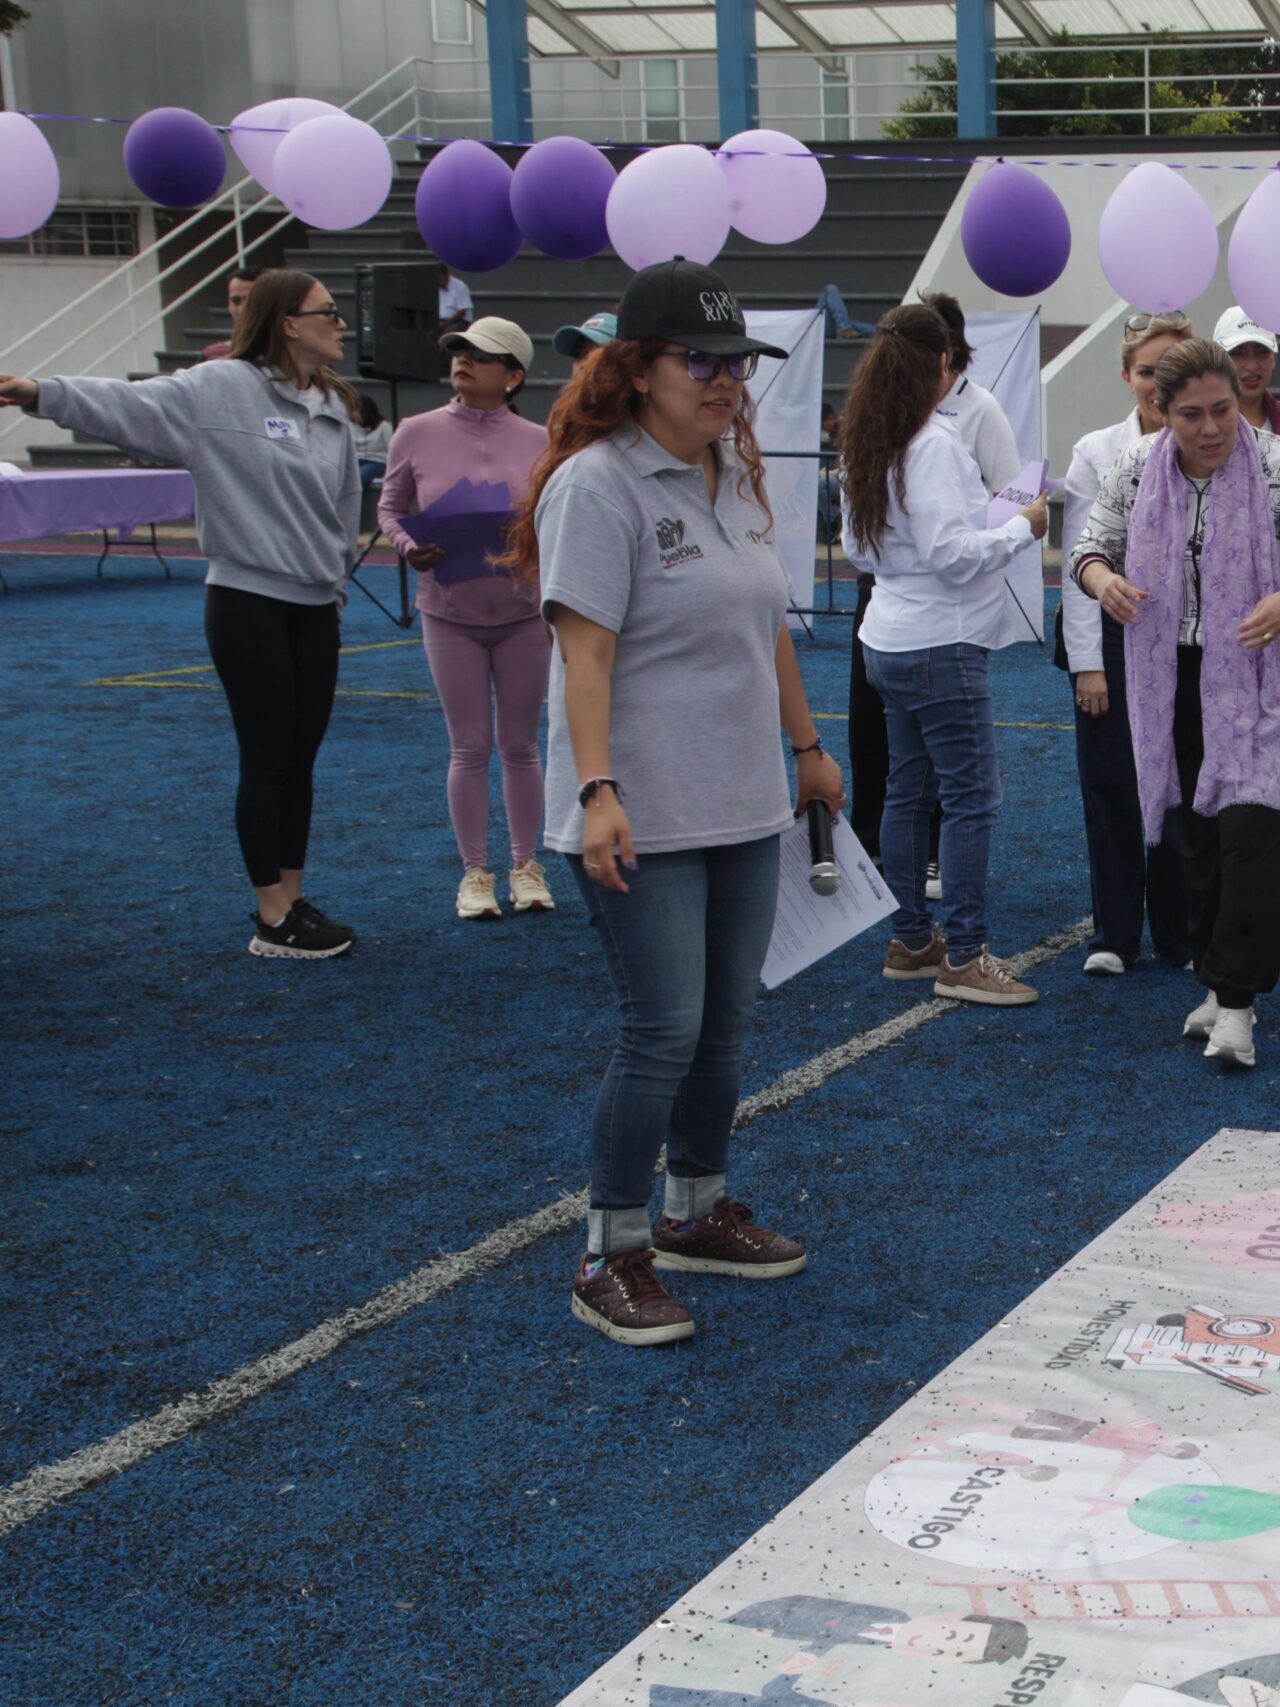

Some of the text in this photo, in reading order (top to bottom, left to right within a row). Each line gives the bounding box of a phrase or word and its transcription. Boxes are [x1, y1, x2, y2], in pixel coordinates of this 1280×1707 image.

[1044, 1300, 1137, 1370] HONESTIDAD
[907, 1467, 1006, 1549] CASTIGO
[992, 1652, 1067, 1707] RESP
